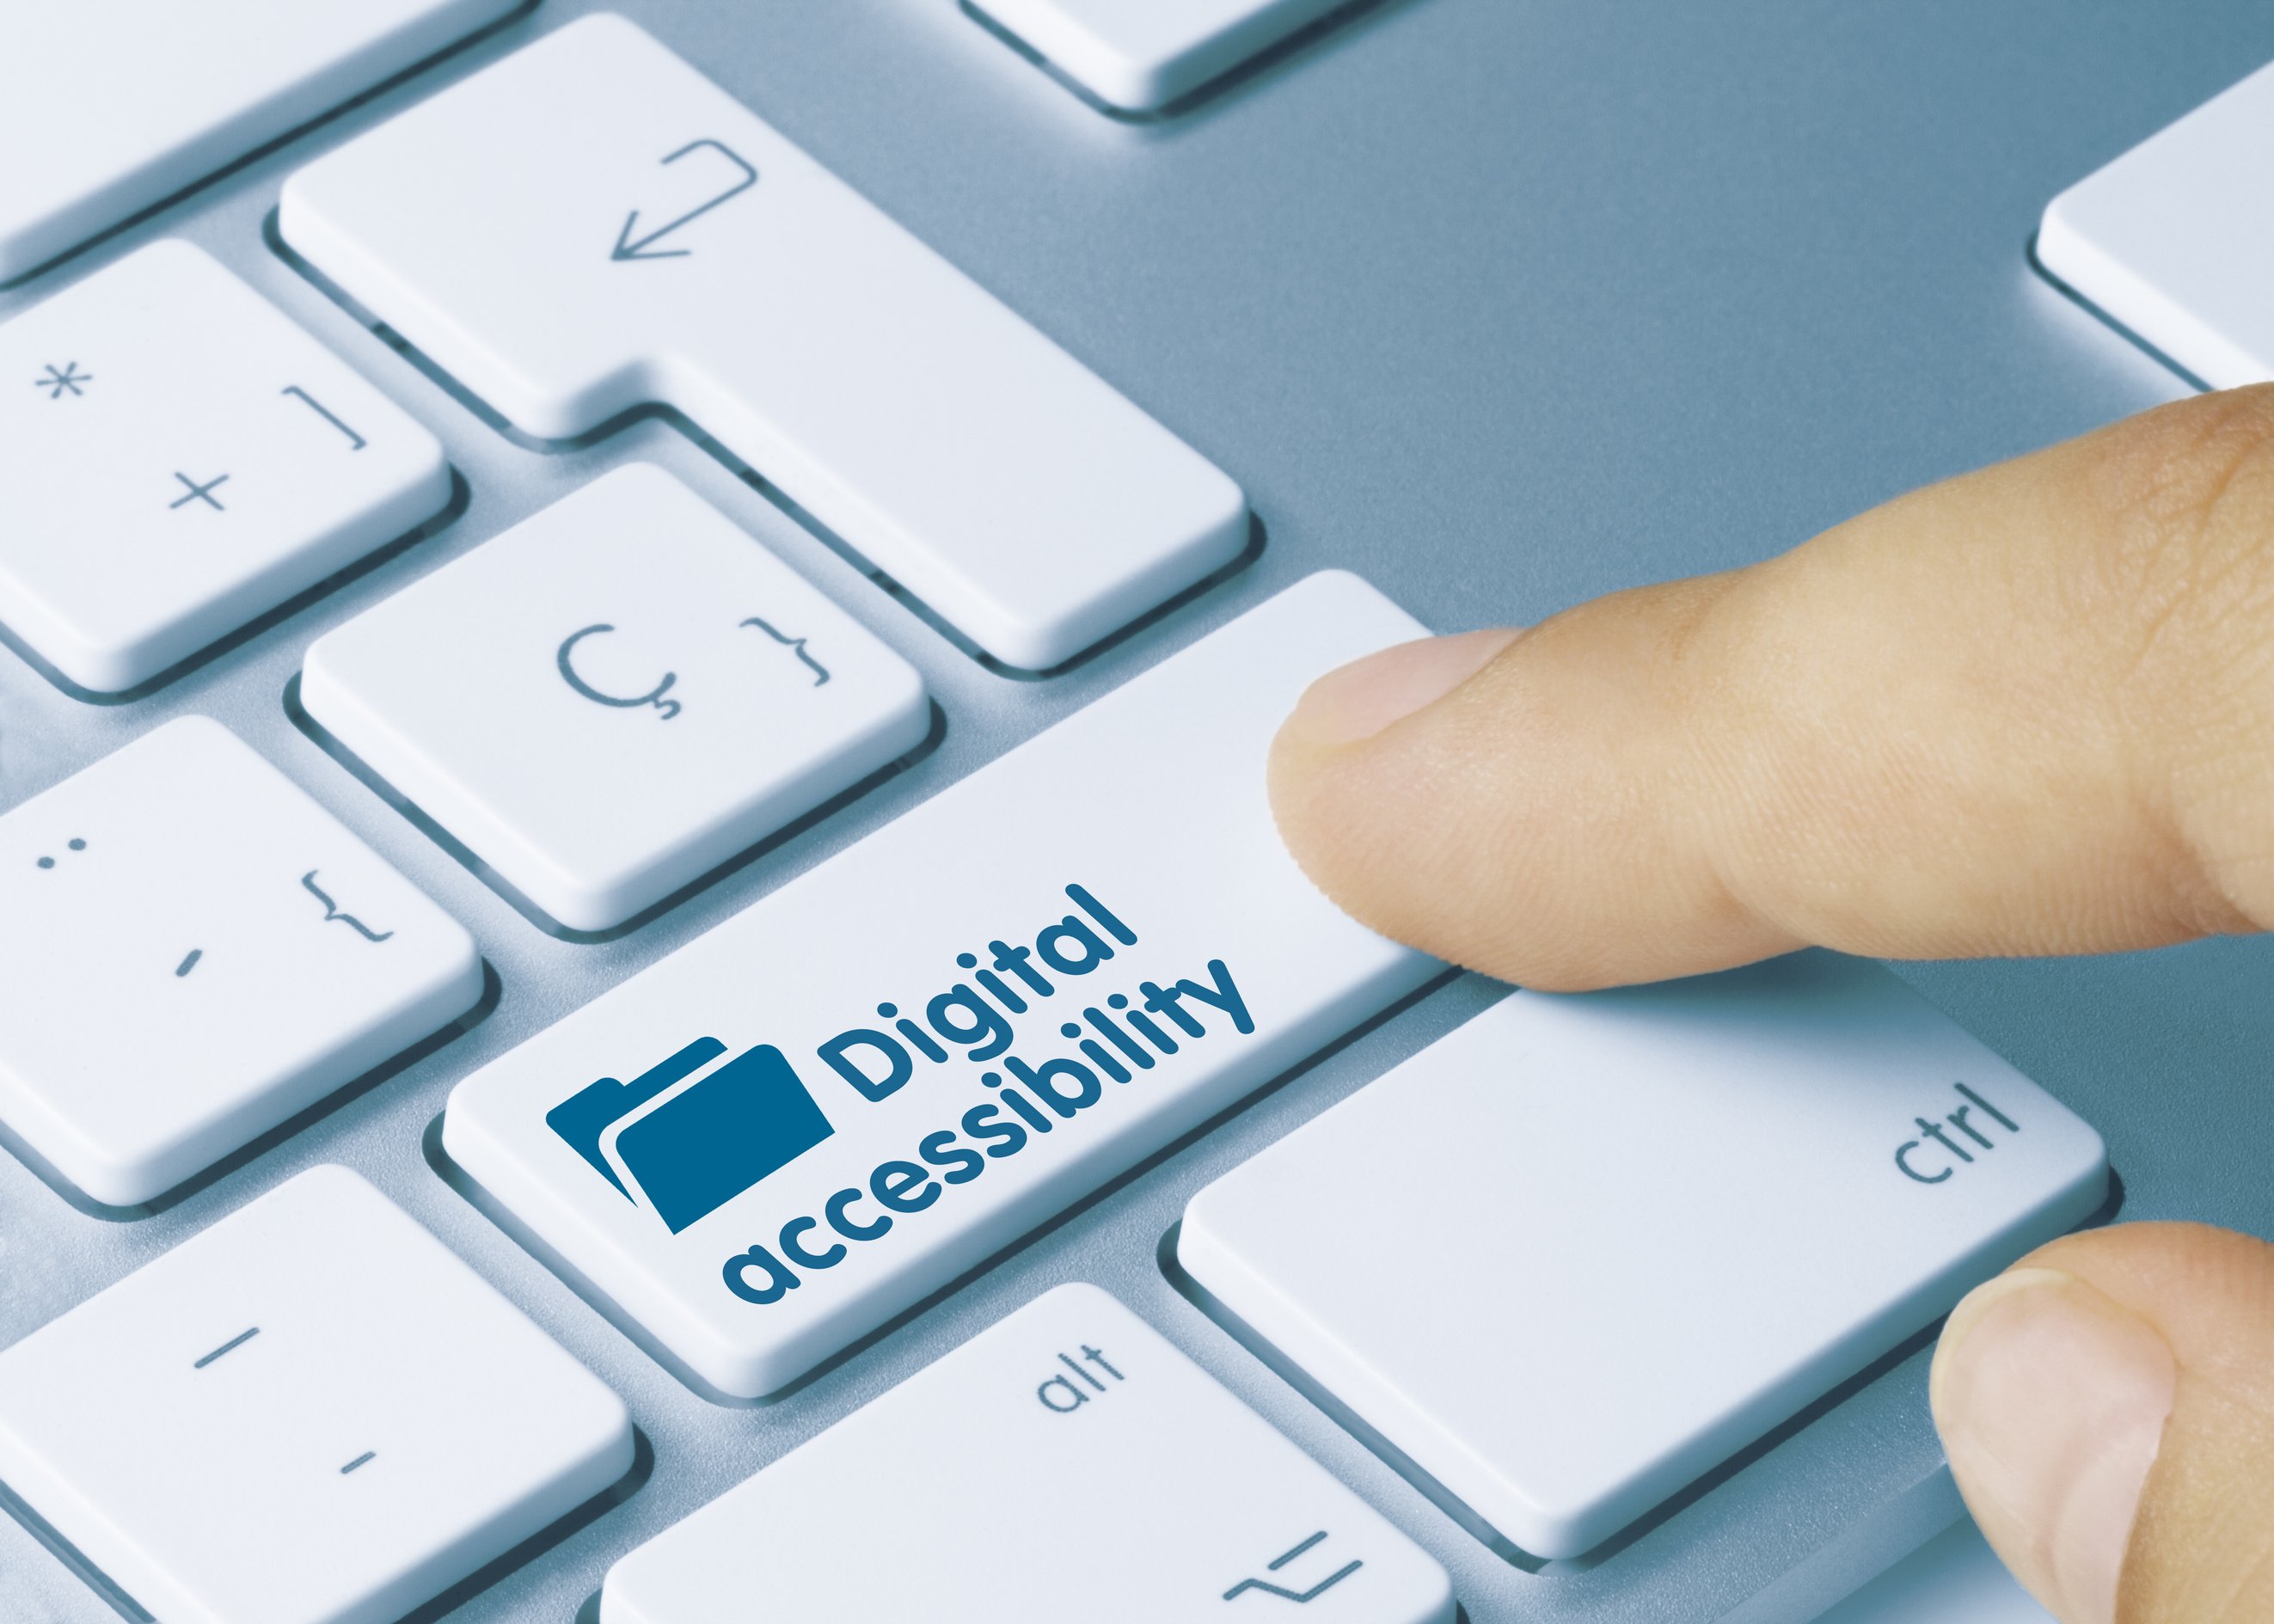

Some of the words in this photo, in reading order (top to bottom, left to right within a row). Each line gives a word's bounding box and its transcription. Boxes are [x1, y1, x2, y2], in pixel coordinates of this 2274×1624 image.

[816, 883, 1138, 1103] Digital
[721, 959, 1255, 1305] accessibility
[1894, 1082, 2020, 1185] ctrl
[1036, 1344, 1125, 1413] alt
